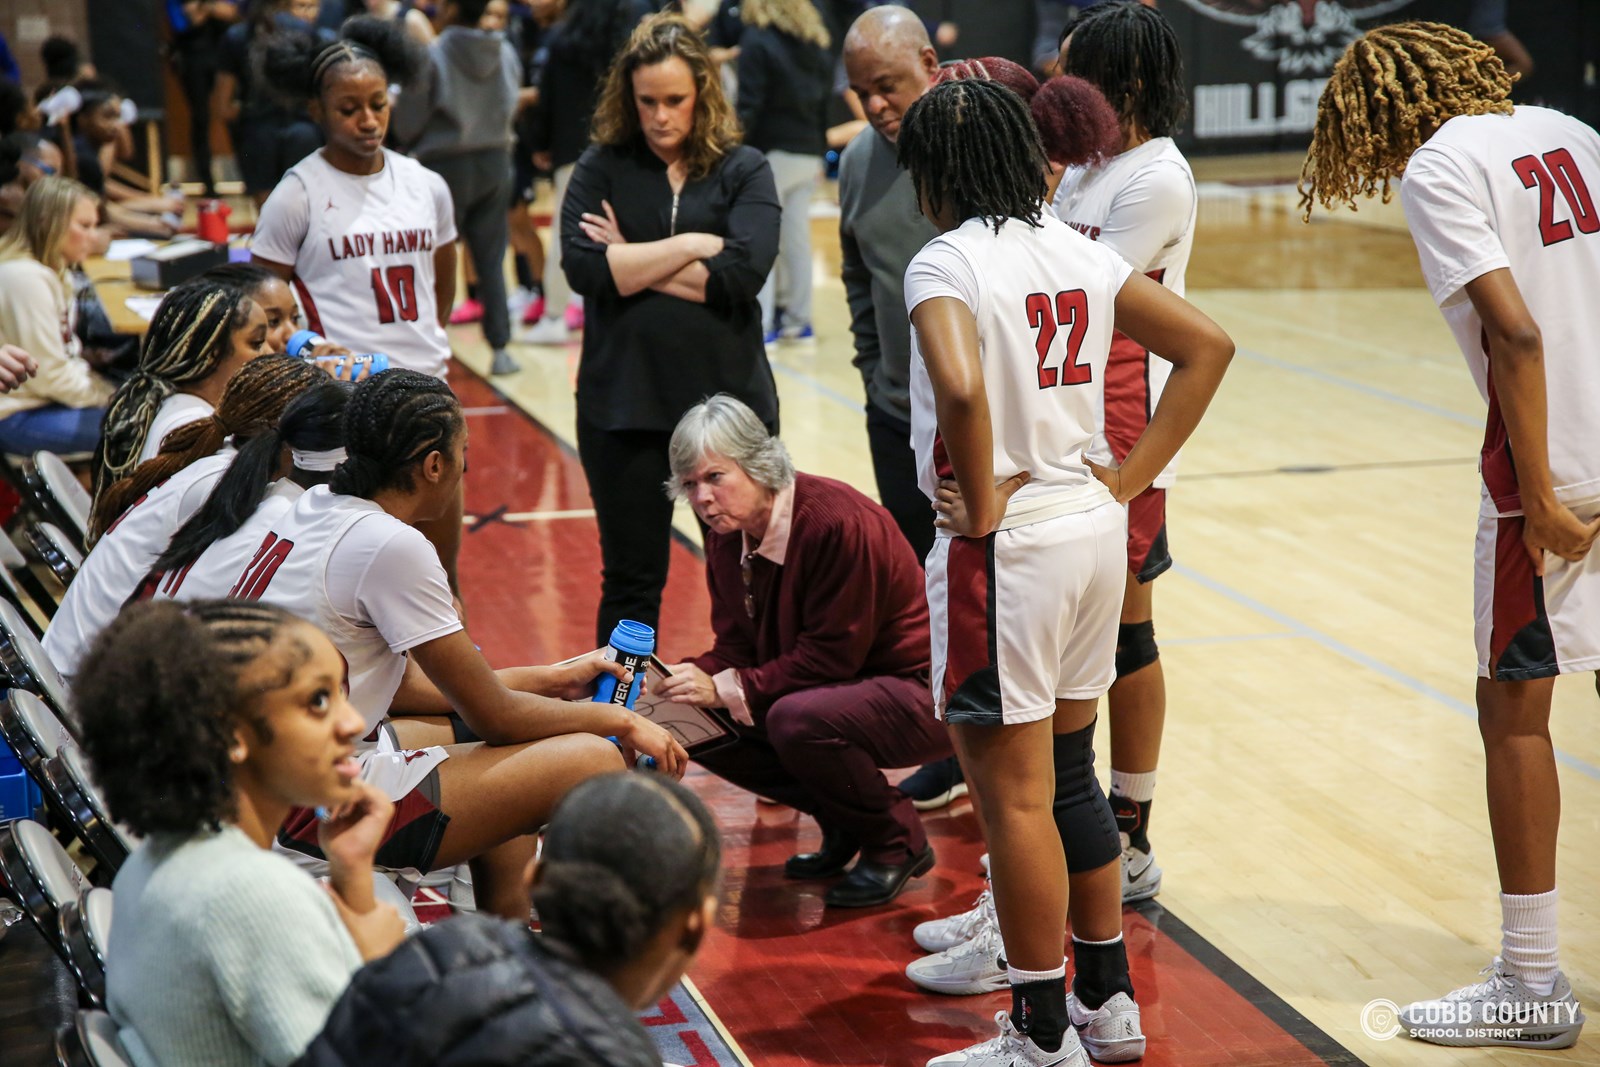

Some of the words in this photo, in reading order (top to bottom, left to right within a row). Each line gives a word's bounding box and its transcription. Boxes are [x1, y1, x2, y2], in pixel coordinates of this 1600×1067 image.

[1511, 147, 1600, 247] 20
[327, 232, 375, 261] LADY
[371, 264, 419, 325] 10
[1025, 288, 1092, 390] 22
